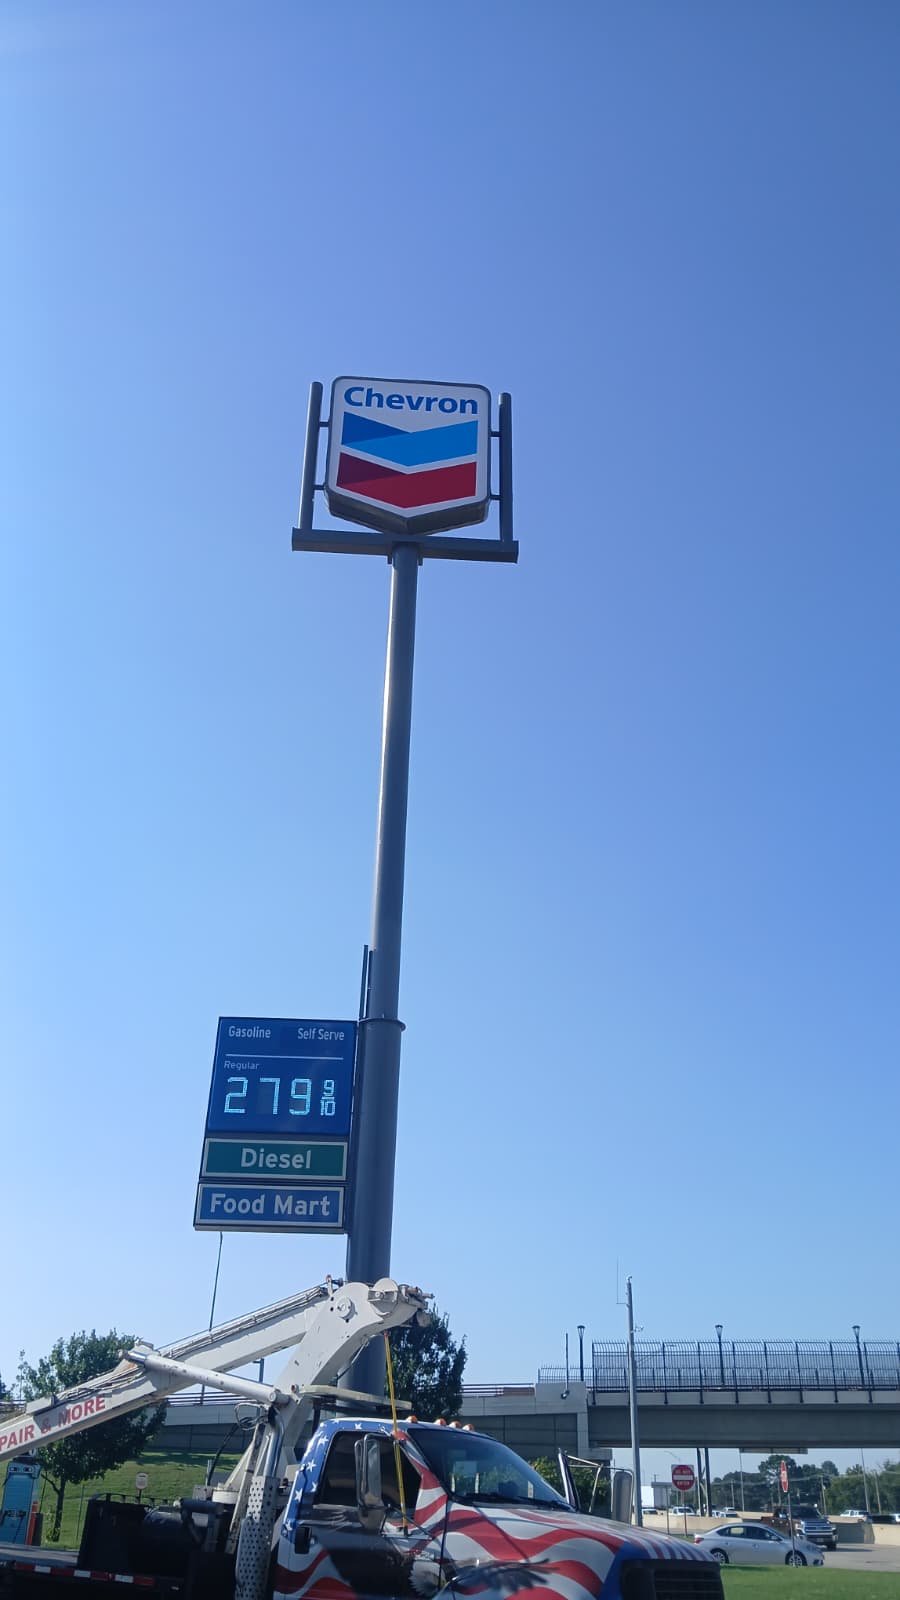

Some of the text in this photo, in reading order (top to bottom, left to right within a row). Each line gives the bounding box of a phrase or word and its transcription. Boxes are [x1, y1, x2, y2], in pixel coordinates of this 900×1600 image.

[344, 386, 478, 415] Chevron
[228, 1025, 271, 1039] Gasoline
[297, 1027, 345, 1041] Self Serve
[223, 1060, 260, 1071] Regular
[223, 1076, 312, 1116] 279
[241, 1148, 312, 1169] Diesel
[210, 1193, 331, 1217] Food Mart
[40, 1418, 52, 1434] &
[57, 1394, 106, 1428] MORE
